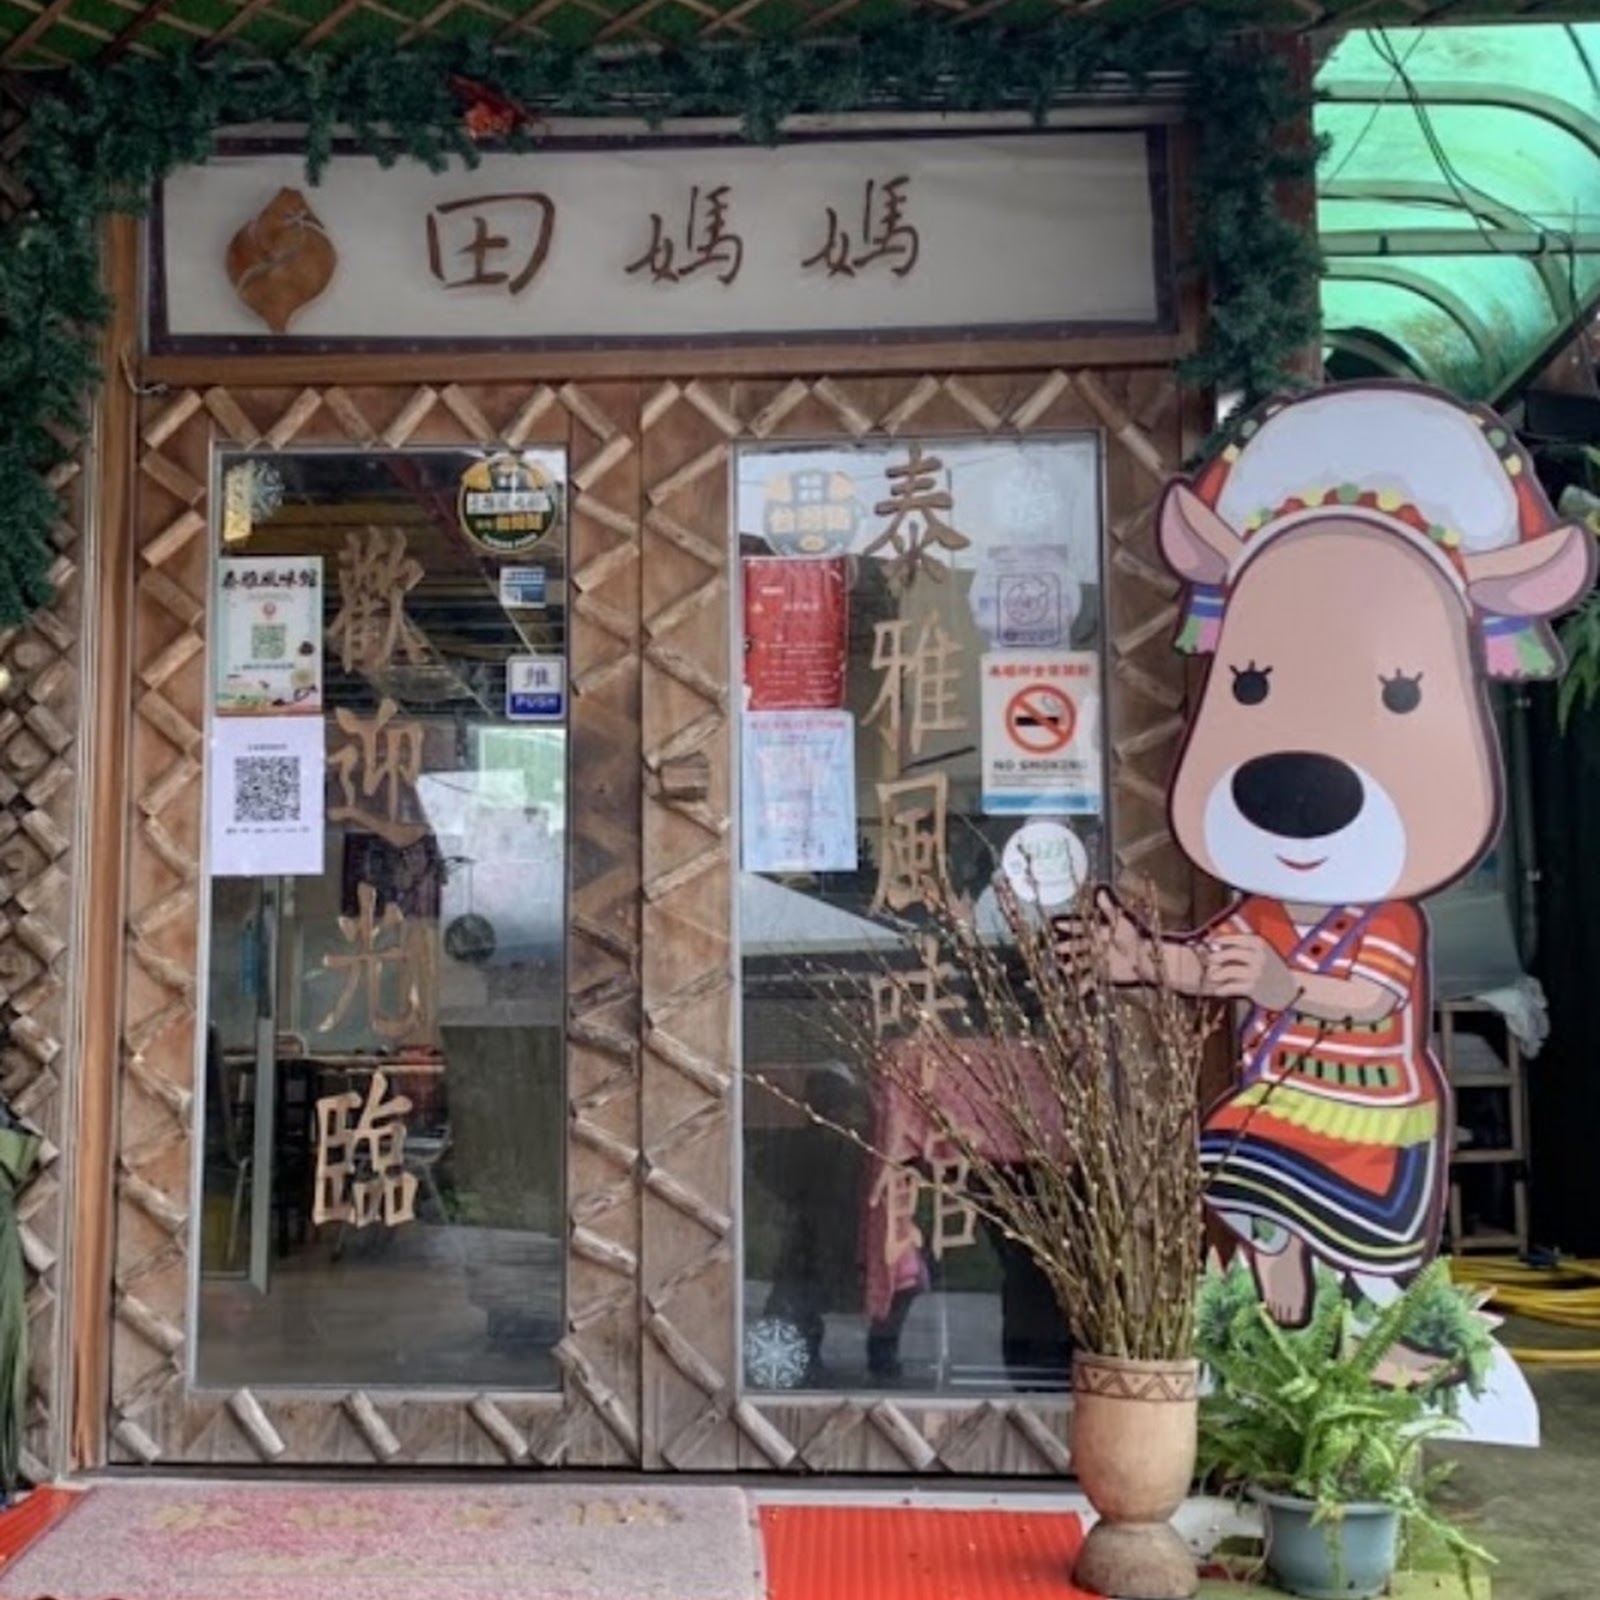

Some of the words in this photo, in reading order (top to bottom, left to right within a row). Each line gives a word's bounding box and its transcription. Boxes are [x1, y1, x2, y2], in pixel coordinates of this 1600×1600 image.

[426, 176, 920, 295] 田媽媽
[993, 759, 1015, 772] NO
[311, 525, 437, 1229] 歡迎光臨
